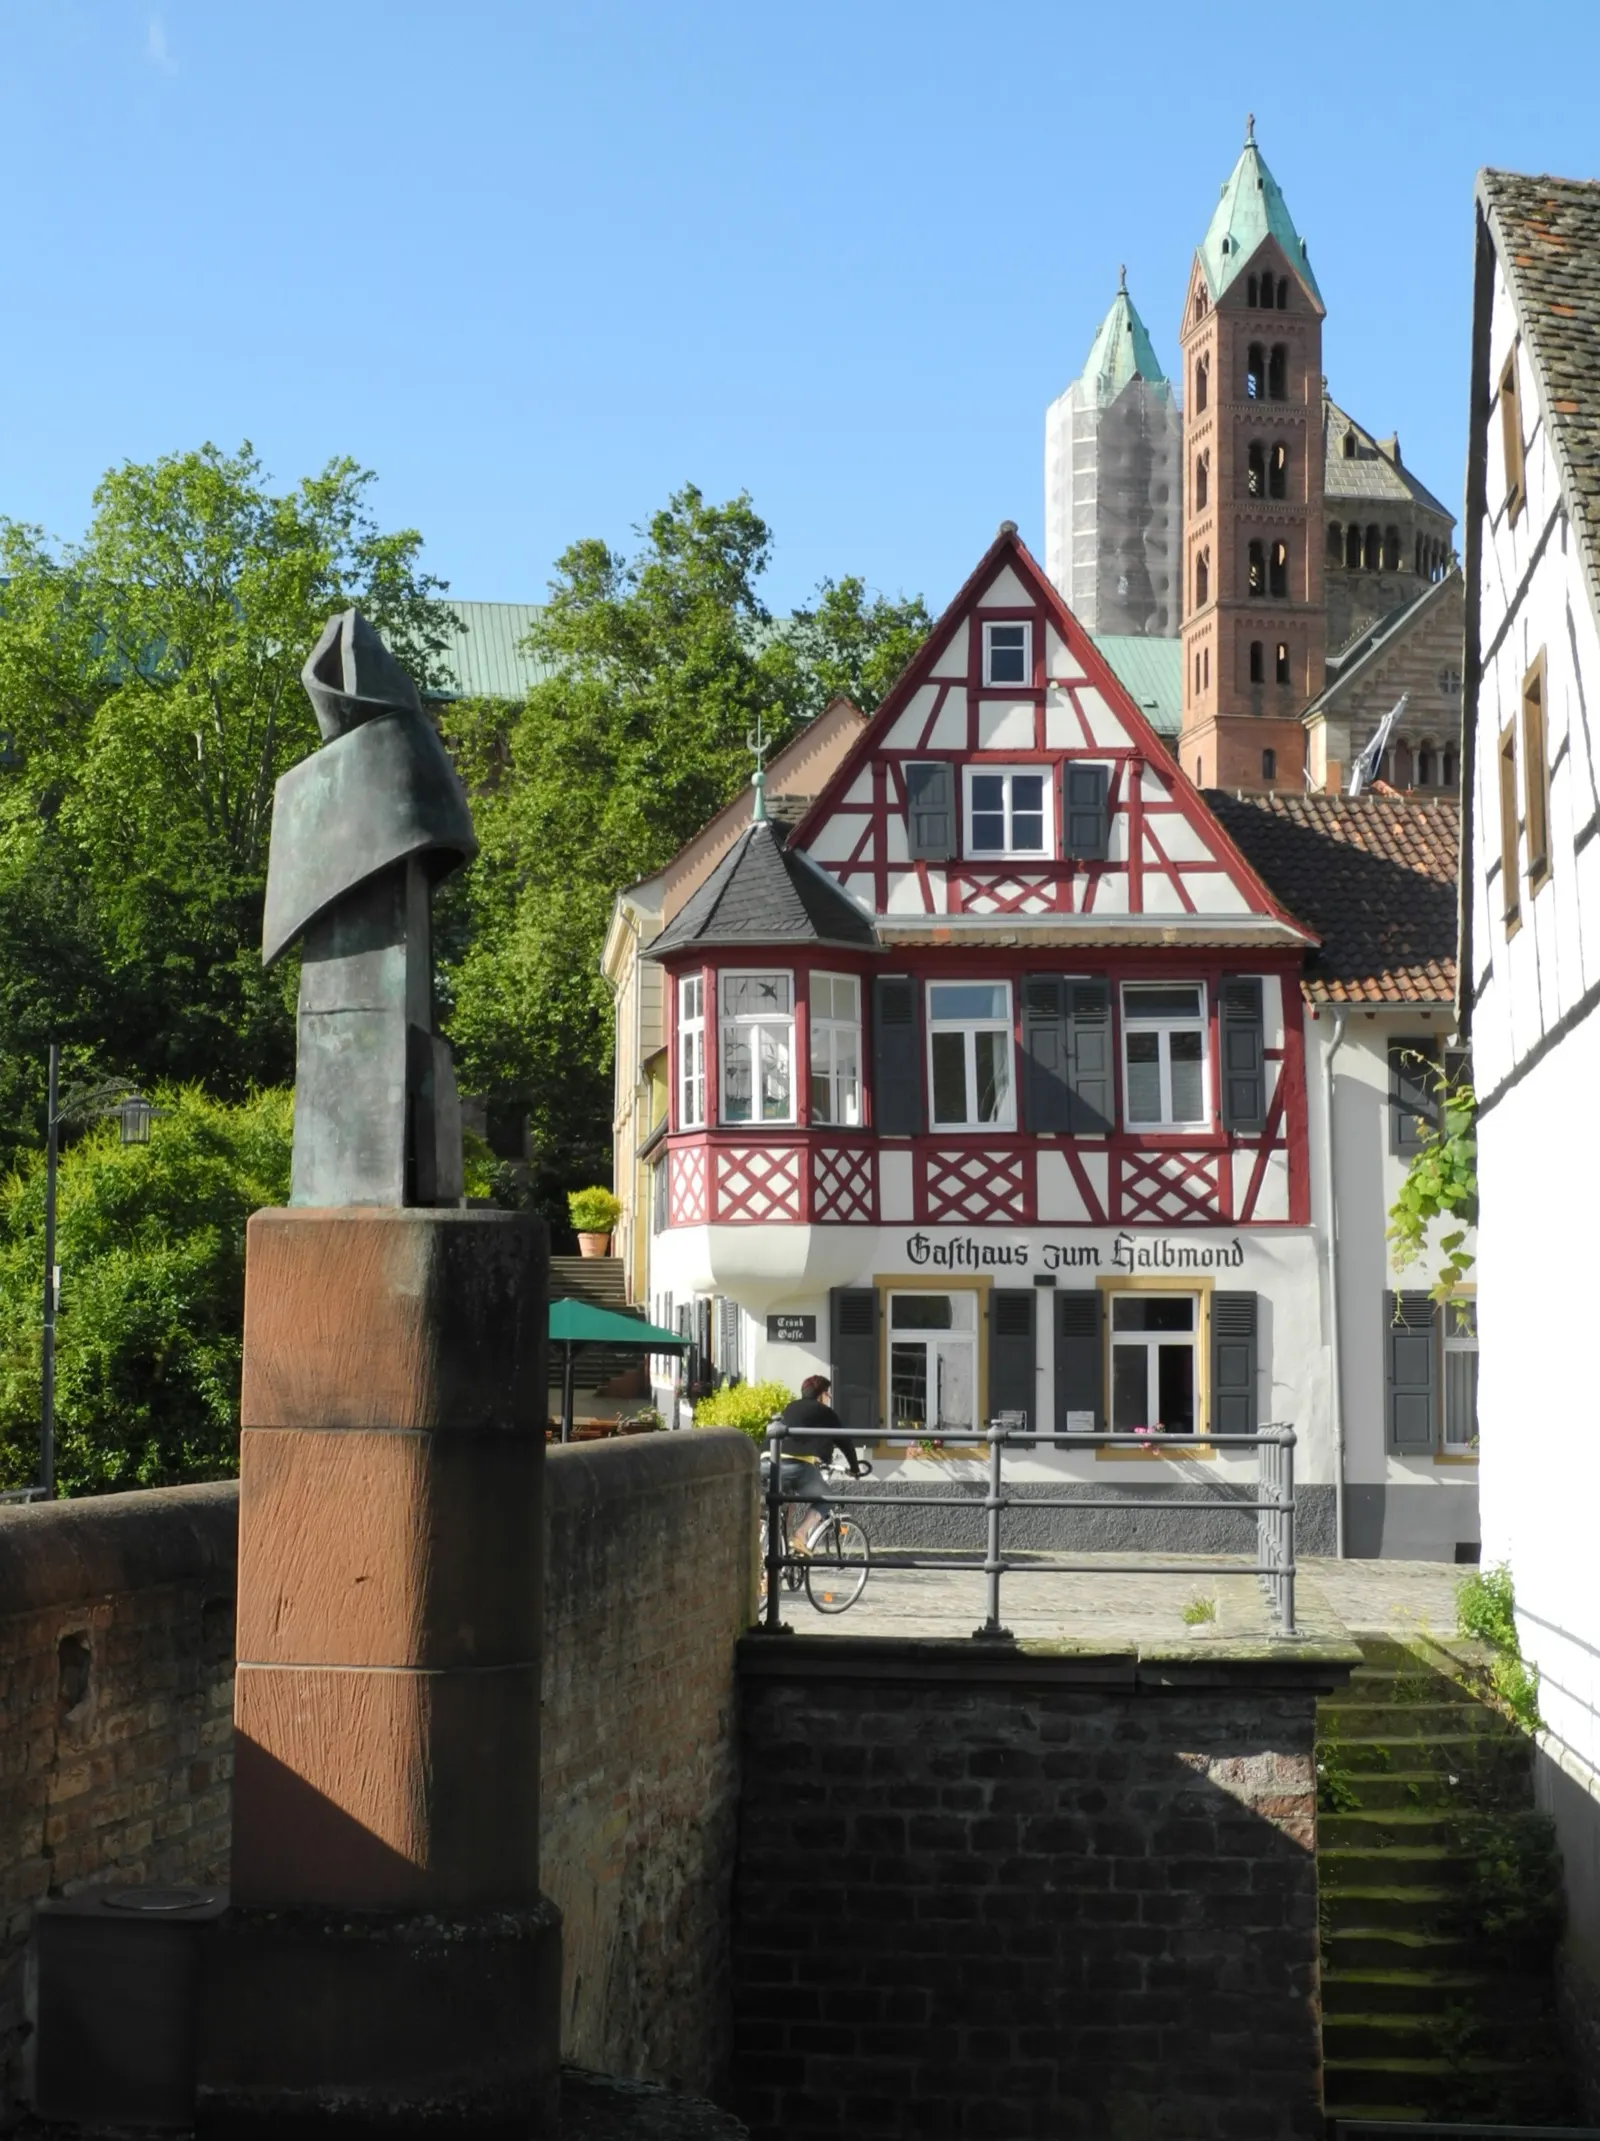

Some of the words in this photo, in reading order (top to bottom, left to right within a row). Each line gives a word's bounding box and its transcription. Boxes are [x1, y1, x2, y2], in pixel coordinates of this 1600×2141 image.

[906, 1232, 1029, 1270] Gasthaus
[1042, 1243, 1102, 1270] zum
[1111, 1231, 1245, 1273] Halbmond
